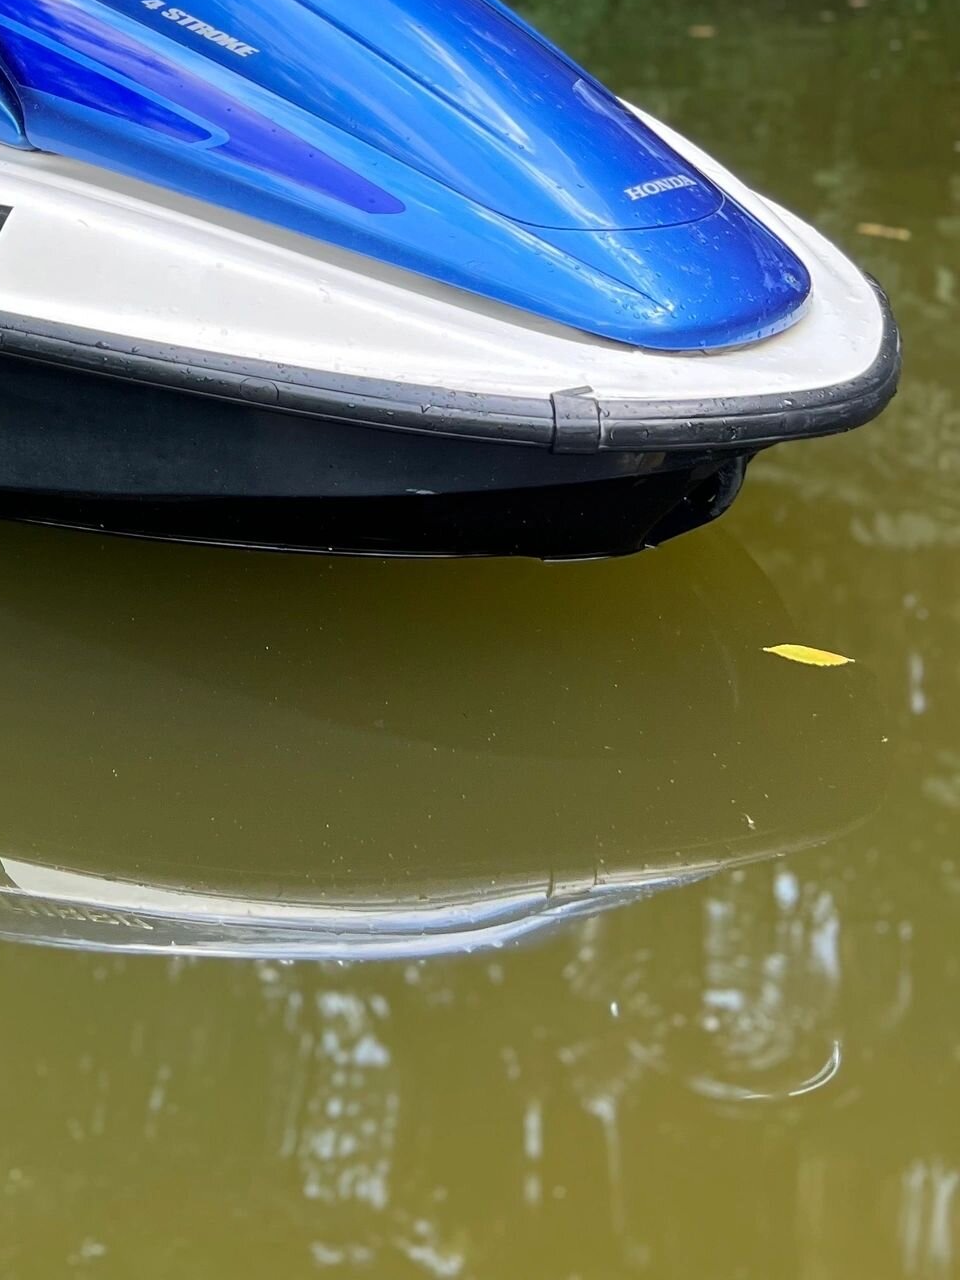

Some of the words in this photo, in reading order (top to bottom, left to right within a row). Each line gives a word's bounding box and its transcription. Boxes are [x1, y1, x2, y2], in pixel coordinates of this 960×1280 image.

[141, 0, 166, 11] 4
[161, 7, 260, 57] STROKE
[623, 174, 697, 201] HONDA
